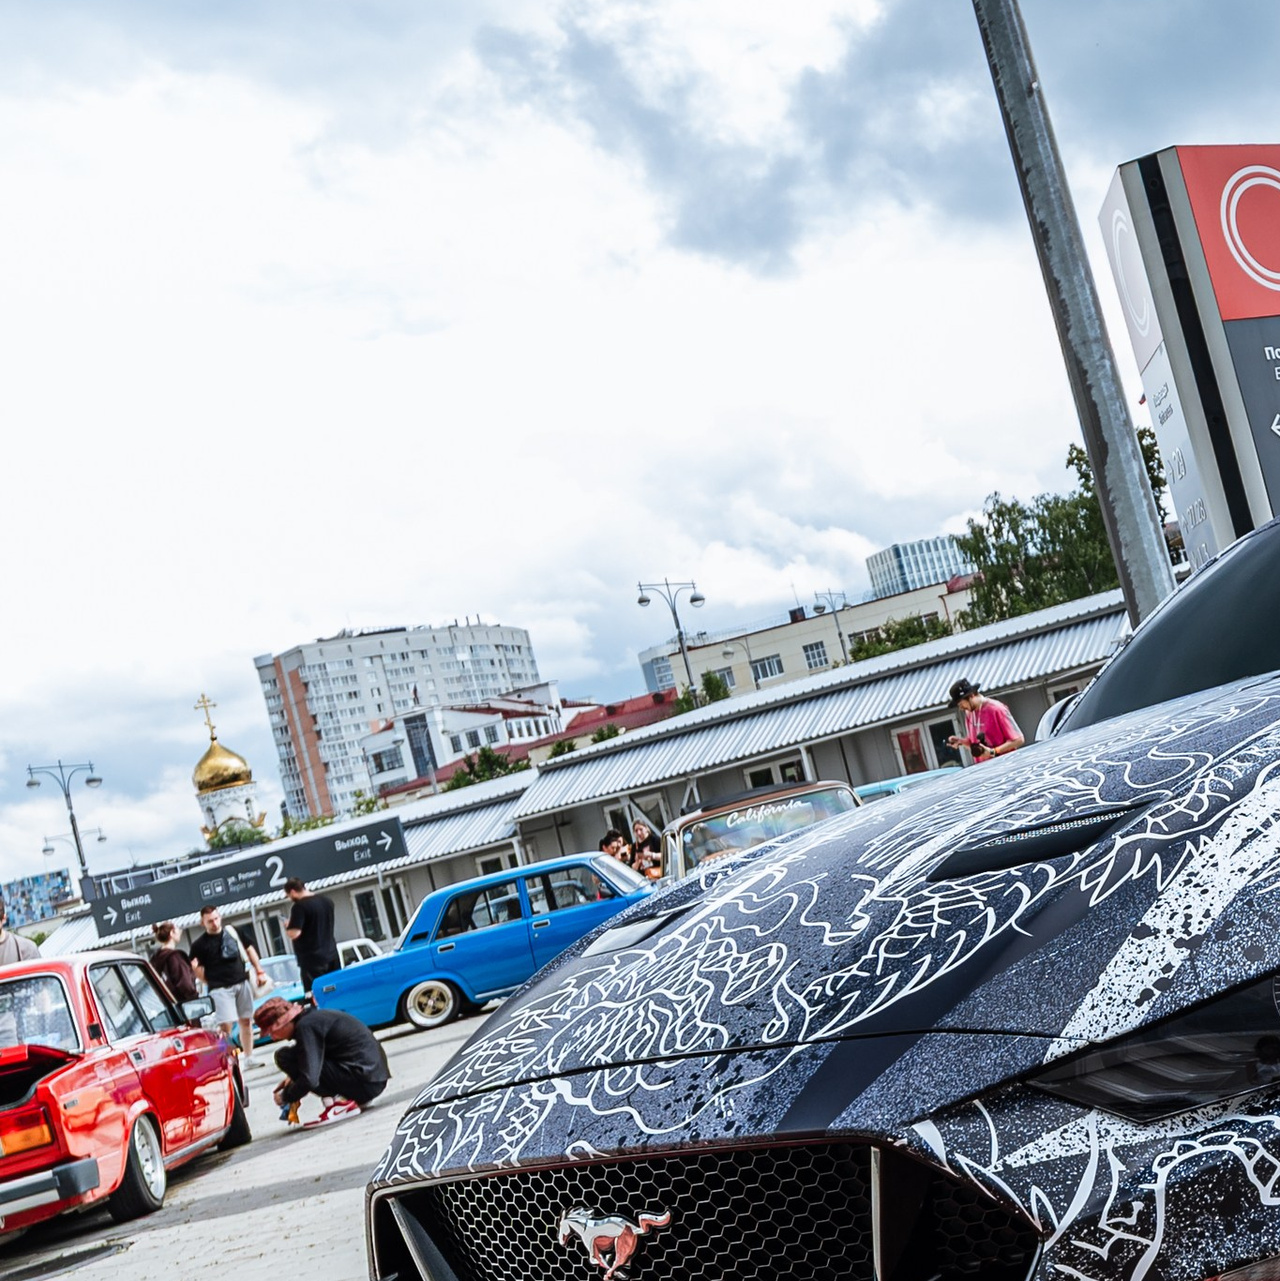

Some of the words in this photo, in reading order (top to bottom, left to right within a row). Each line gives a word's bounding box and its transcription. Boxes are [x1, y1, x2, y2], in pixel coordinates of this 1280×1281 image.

[726, 799, 812, 829] California
[335, 834, 369, 851] Выход
[354, 848, 371, 862] Exit
[265, 855, 288, 888] 2
[120, 893, 152, 910] Выход
[125, 910, 142, 925] Exit
